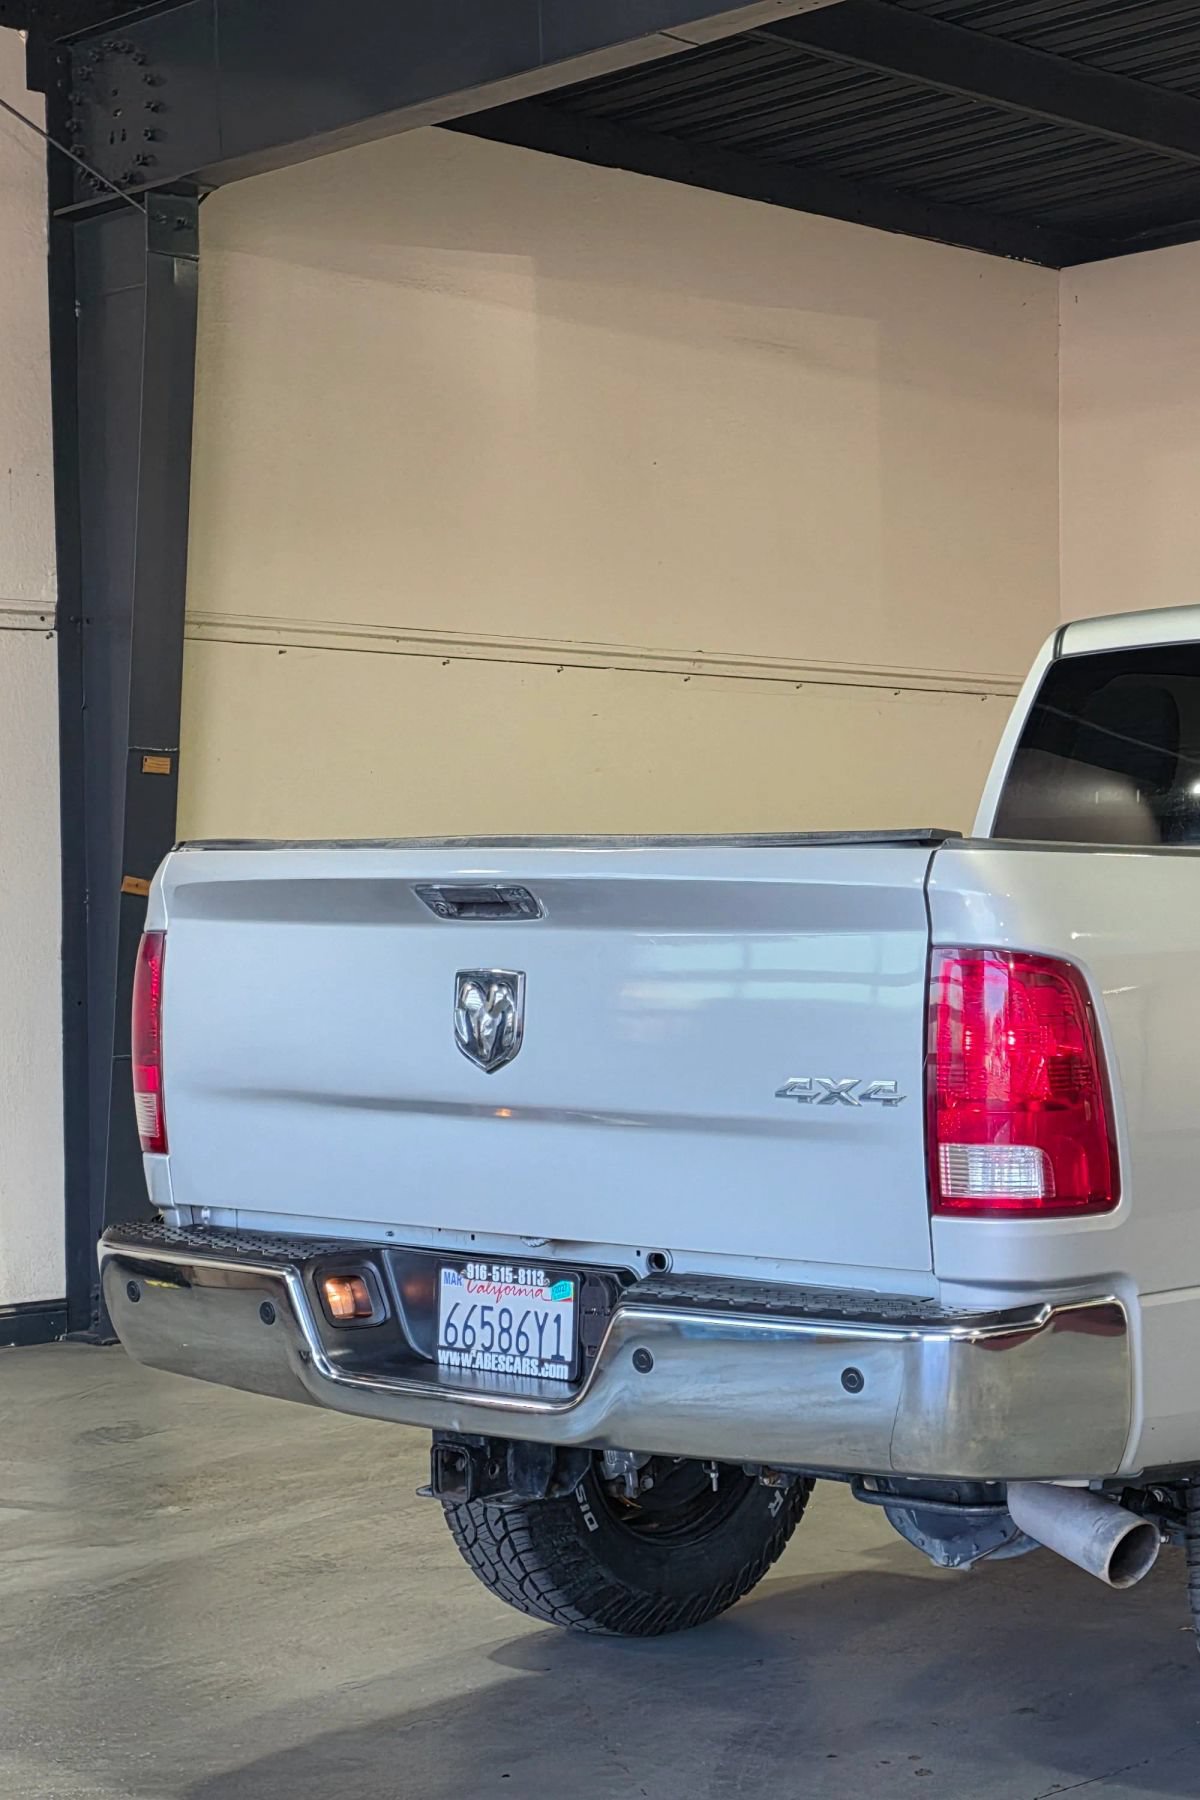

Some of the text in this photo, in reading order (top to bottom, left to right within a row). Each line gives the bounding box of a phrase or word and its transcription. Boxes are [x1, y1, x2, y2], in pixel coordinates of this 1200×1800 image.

[444, 1272, 462, 1286] MAR
[466, 1263, 545, 1287] 916-515-8113
[467, 1279, 551, 1304] California
[444, 1302, 565, 1363] 66586Y1
